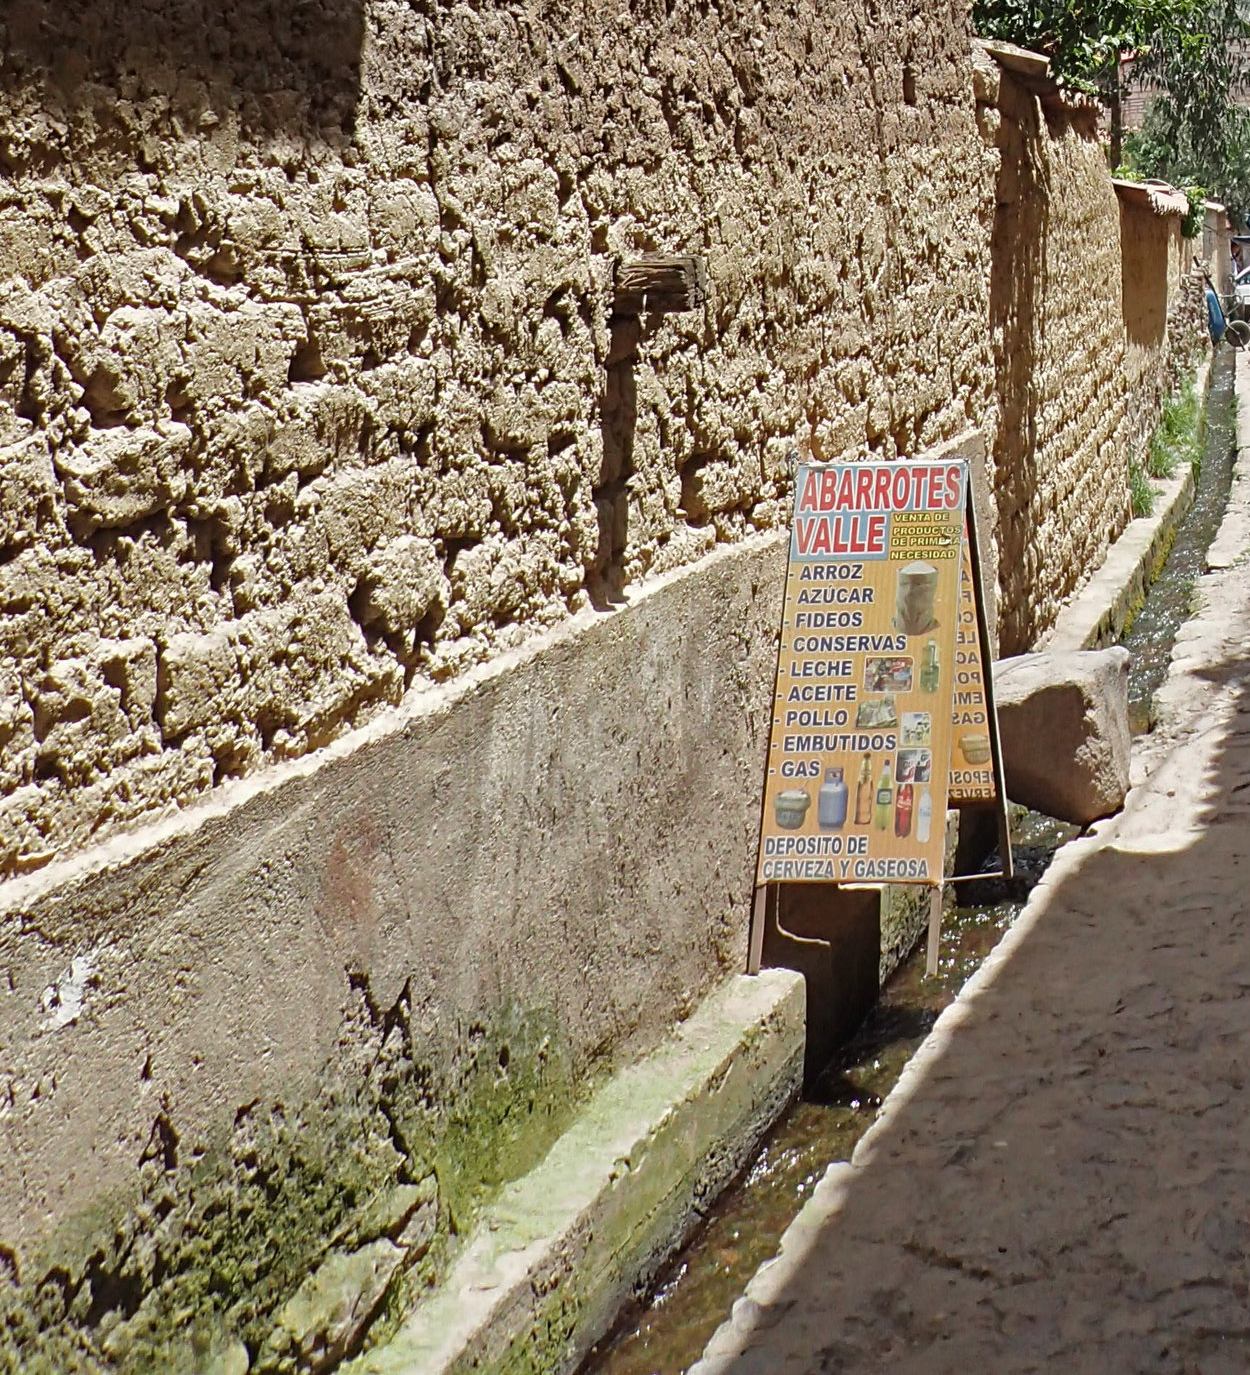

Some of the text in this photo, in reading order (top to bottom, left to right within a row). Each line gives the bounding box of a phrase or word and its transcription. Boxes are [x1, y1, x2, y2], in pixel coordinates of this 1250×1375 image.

[799, 467, 962, 512] ABARROTES
[894, 512, 949, 522] VENTA DE
[795, 516, 886, 554] VALLE
[893, 525, 961, 535] PRODUCTOS
[891, 537, 907, 546] DE
[890, 550, 956, 560] NECESIDAD
[800, 564, 863, 580] ARROZ
[797, 585, 874, 604] AZÚCAR
[795, 612, 863, 628] FIDEOS
[793, 635, 907, 652] CONSERVAS
[791, 661, 853, 676] LECHE
[788, 685, 857, 702] ACEITE
[786, 710, 848, 727] POLLO
[783, 734, 897, 752] EMBUTIDOS
[781, 760, 821, 777] GAS
[765, 836, 868, 855] DEPOSITO DE
[763, 859, 929, 879] CERVEZA Y GASEOSA
